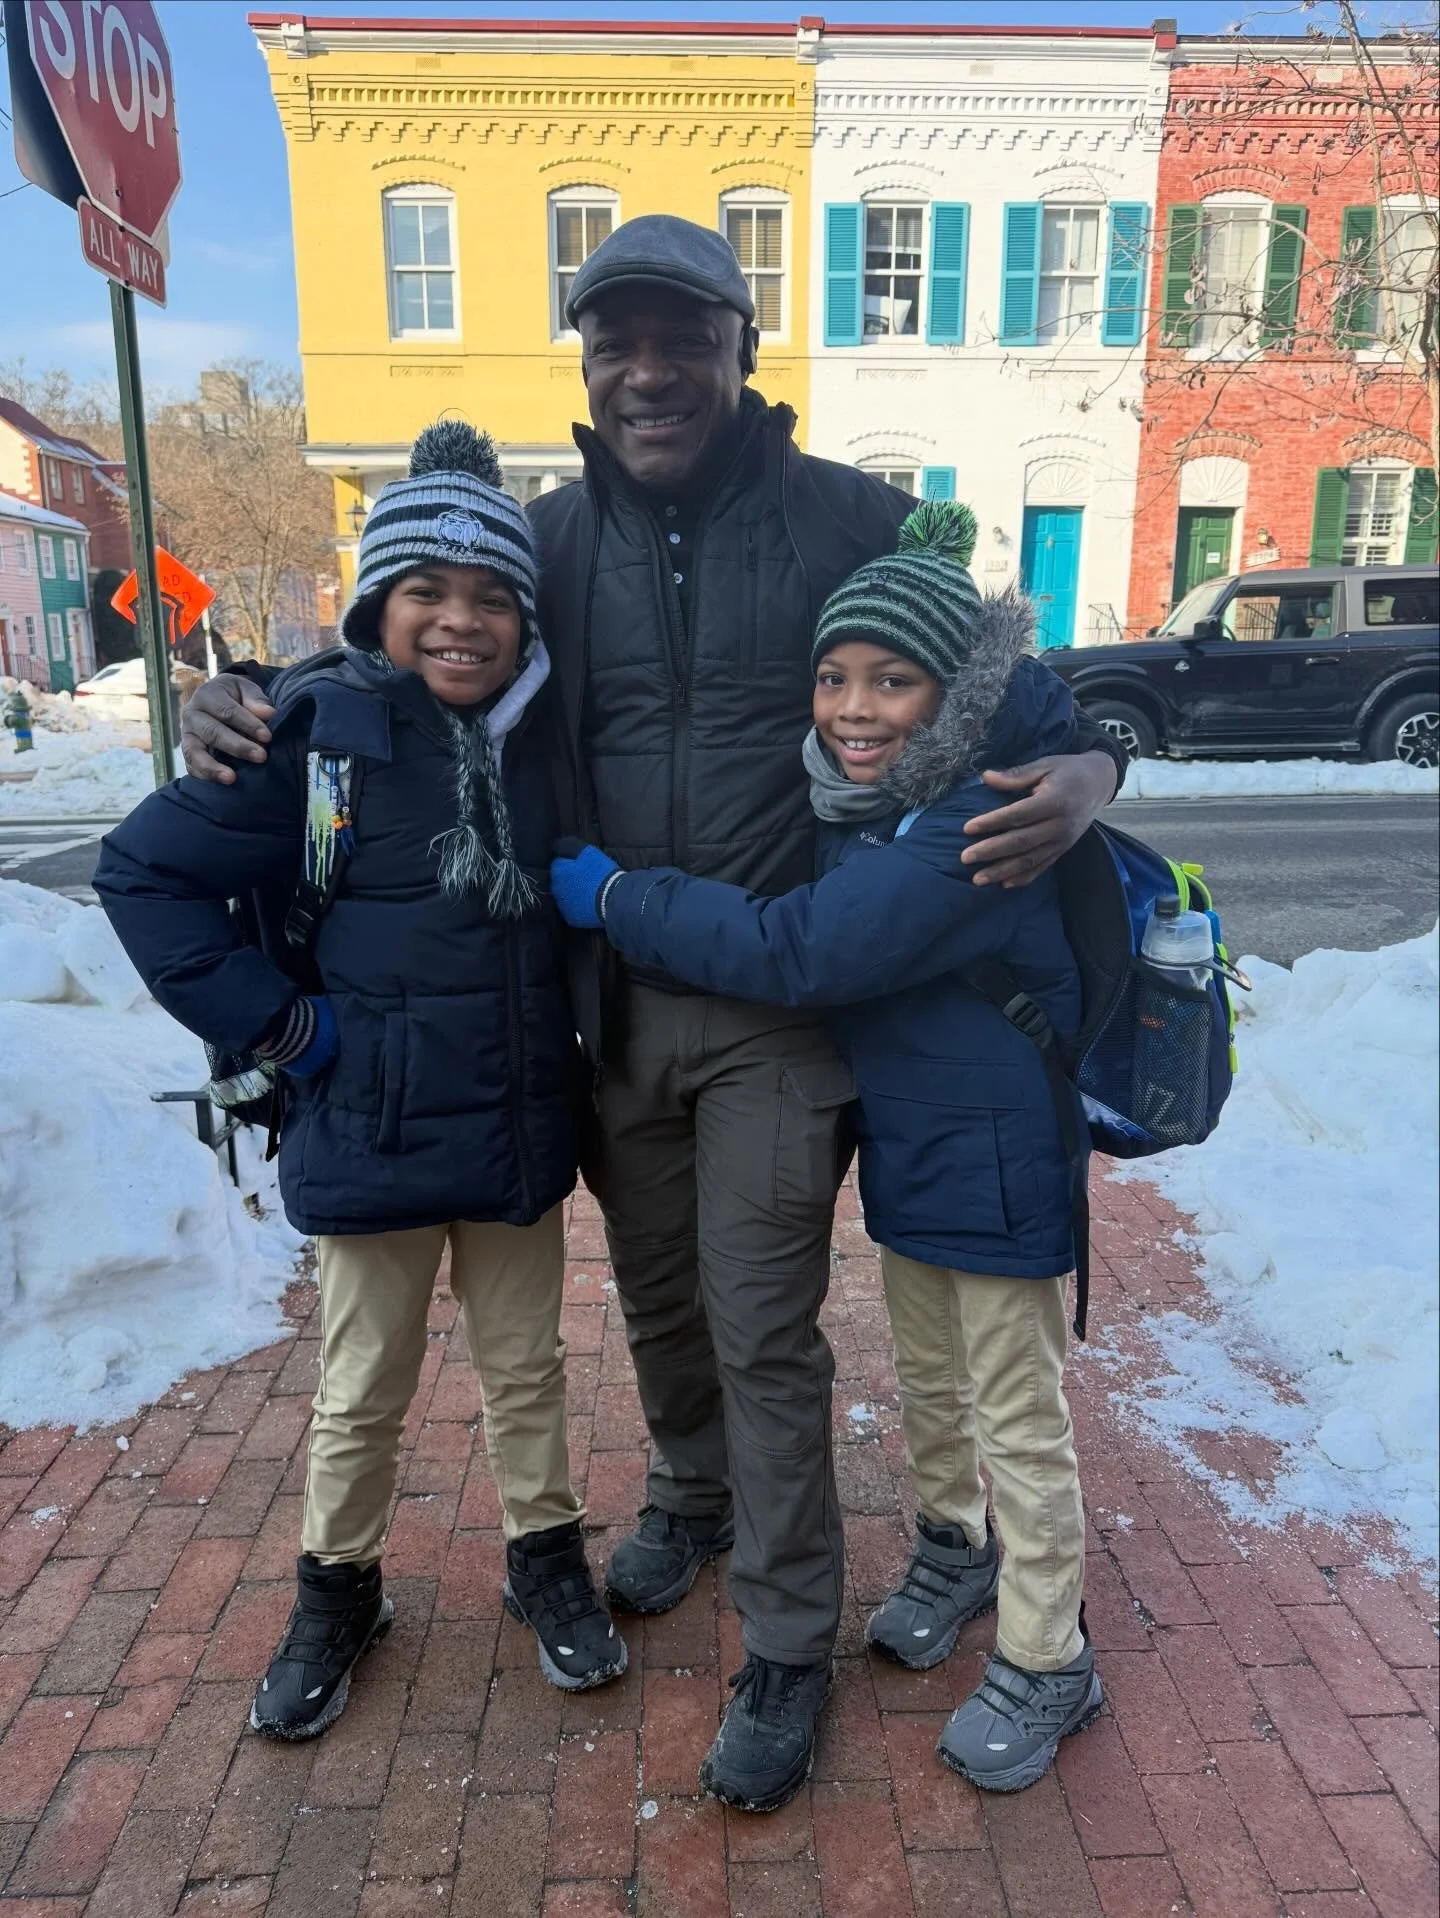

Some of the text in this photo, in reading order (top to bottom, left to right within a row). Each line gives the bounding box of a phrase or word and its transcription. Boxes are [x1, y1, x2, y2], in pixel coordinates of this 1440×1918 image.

[40, 0, 167, 149] STOP
[90, 217, 158, 290] ALL WAY
